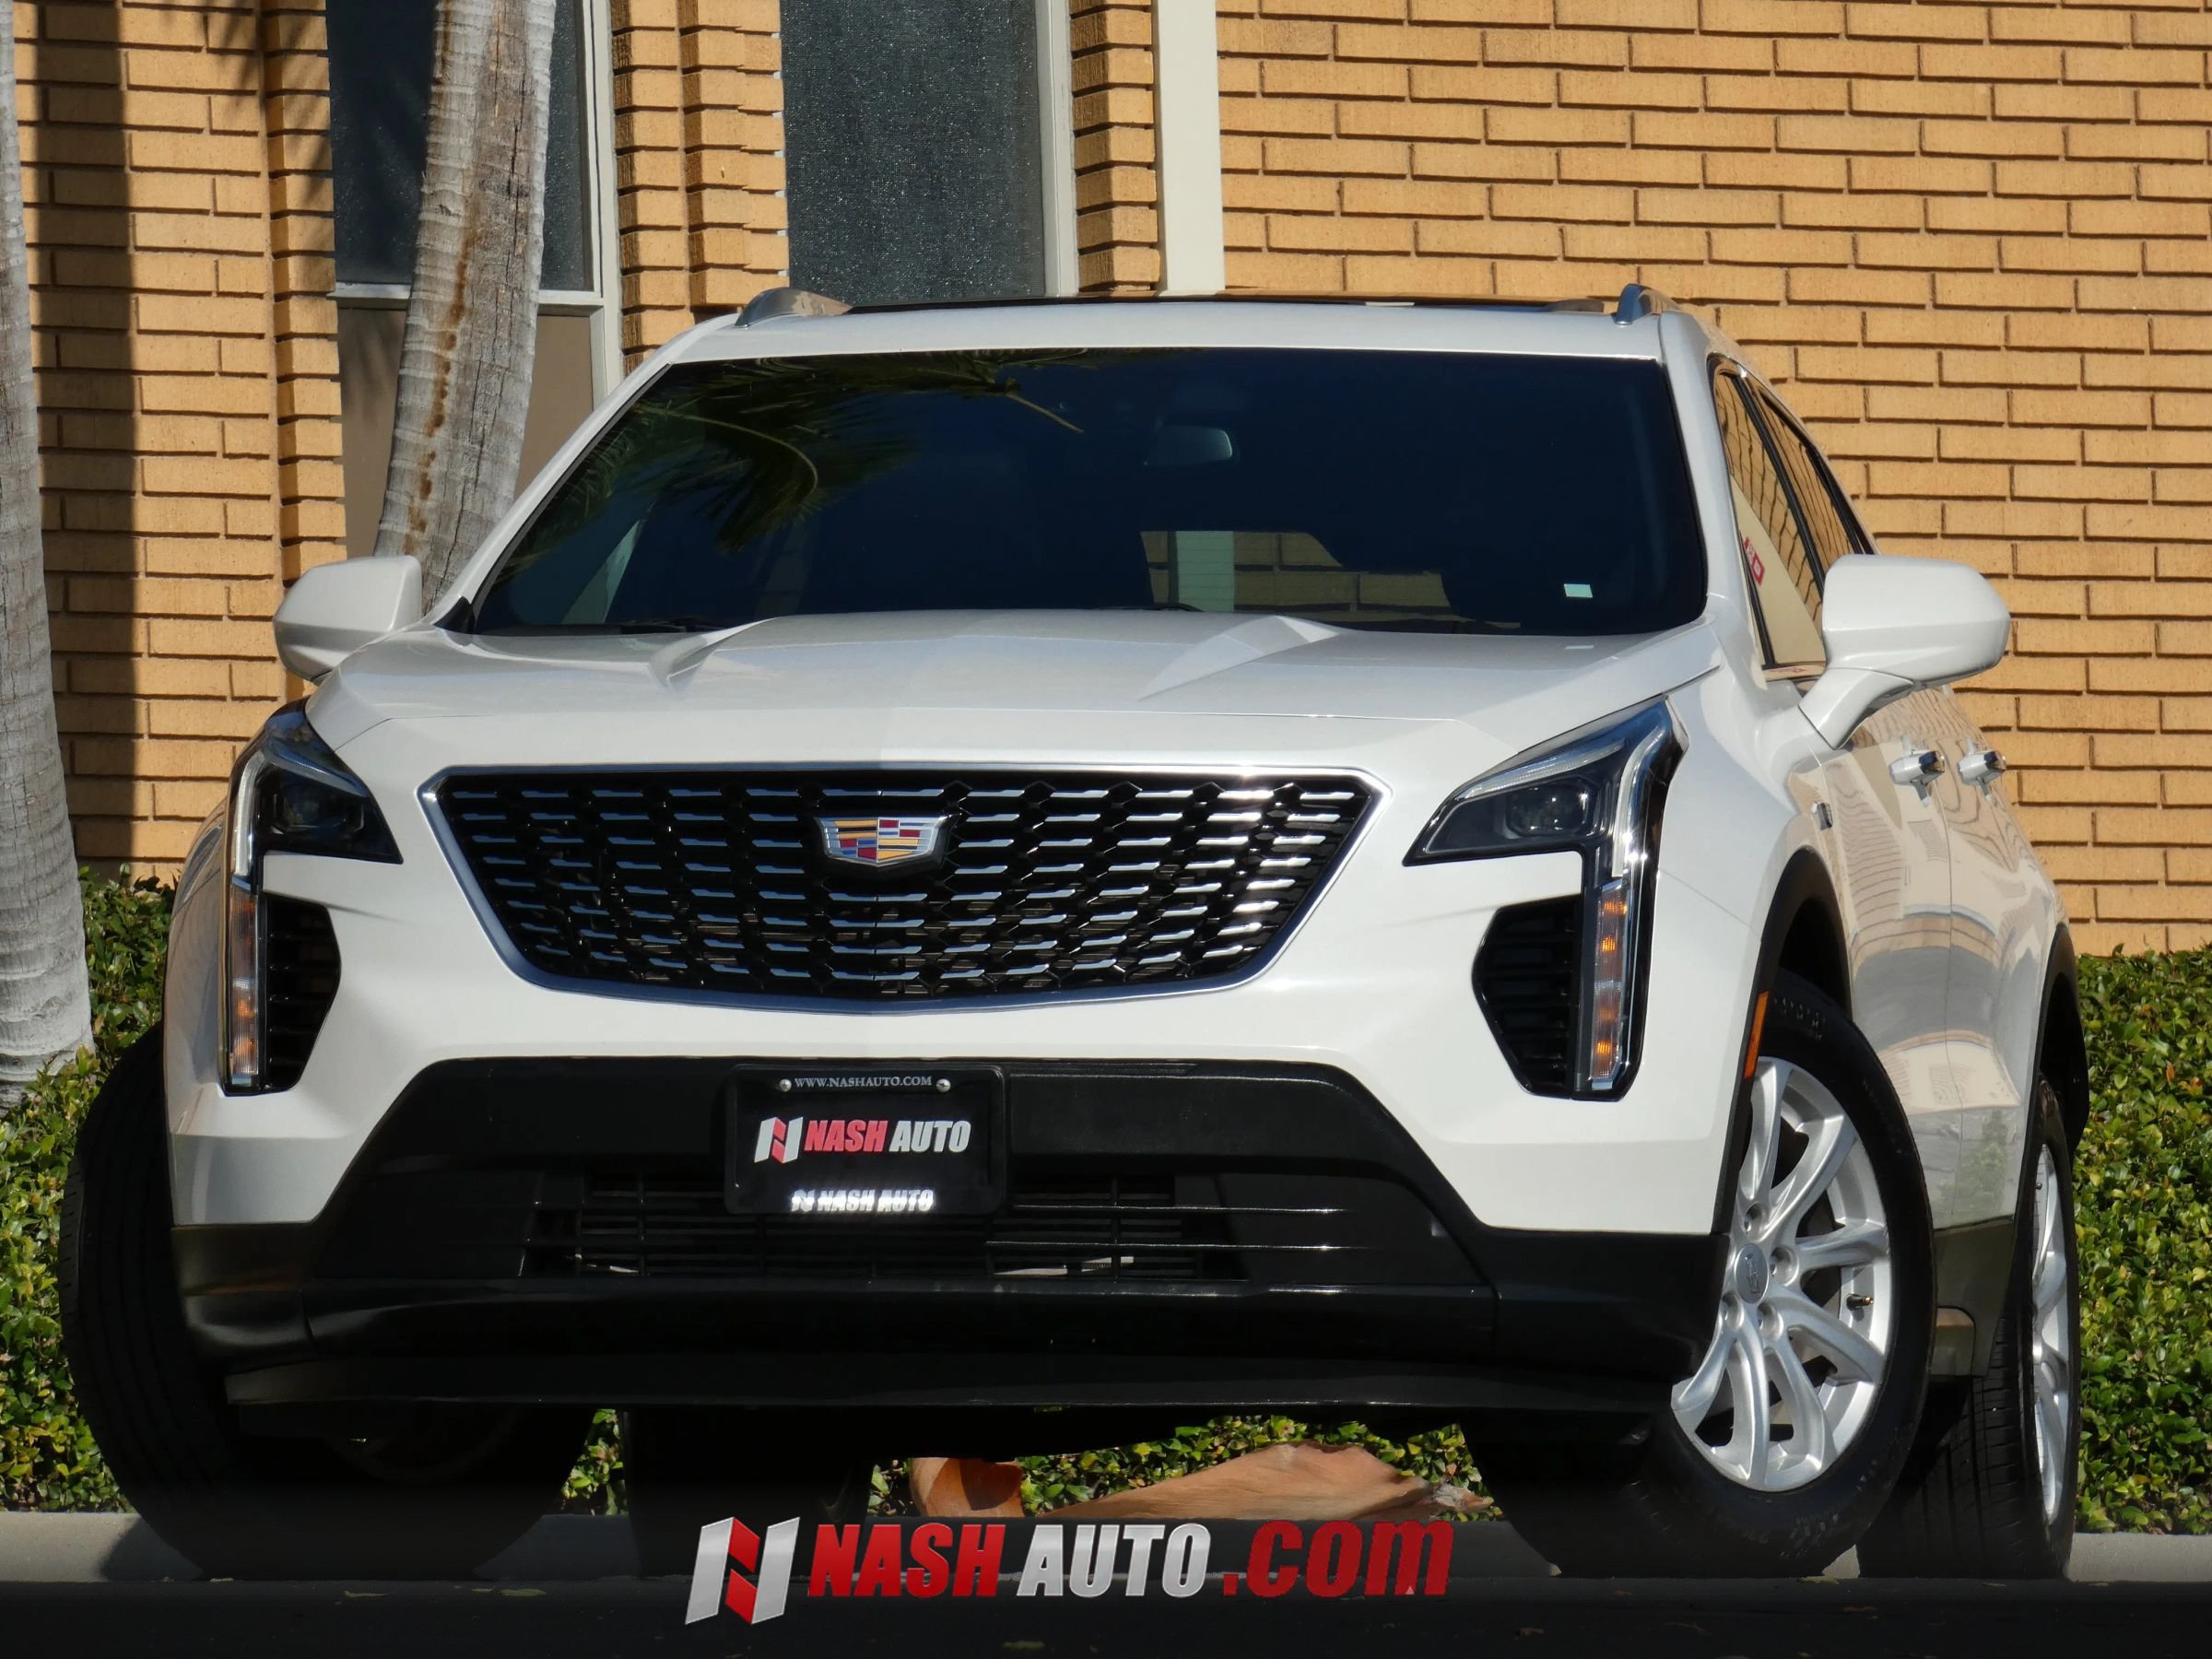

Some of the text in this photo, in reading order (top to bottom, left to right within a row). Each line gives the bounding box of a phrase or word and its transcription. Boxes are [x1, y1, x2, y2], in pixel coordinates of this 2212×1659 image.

[794, 1076, 933, 1088] WWW.NASHAUTO.COM
[804, 1119, 888, 1152] NASH
[888, 1120, 971, 1152] AUTO
[817, 1189, 876, 1212] NASH
[877, 1189, 935, 1212] AUTO
